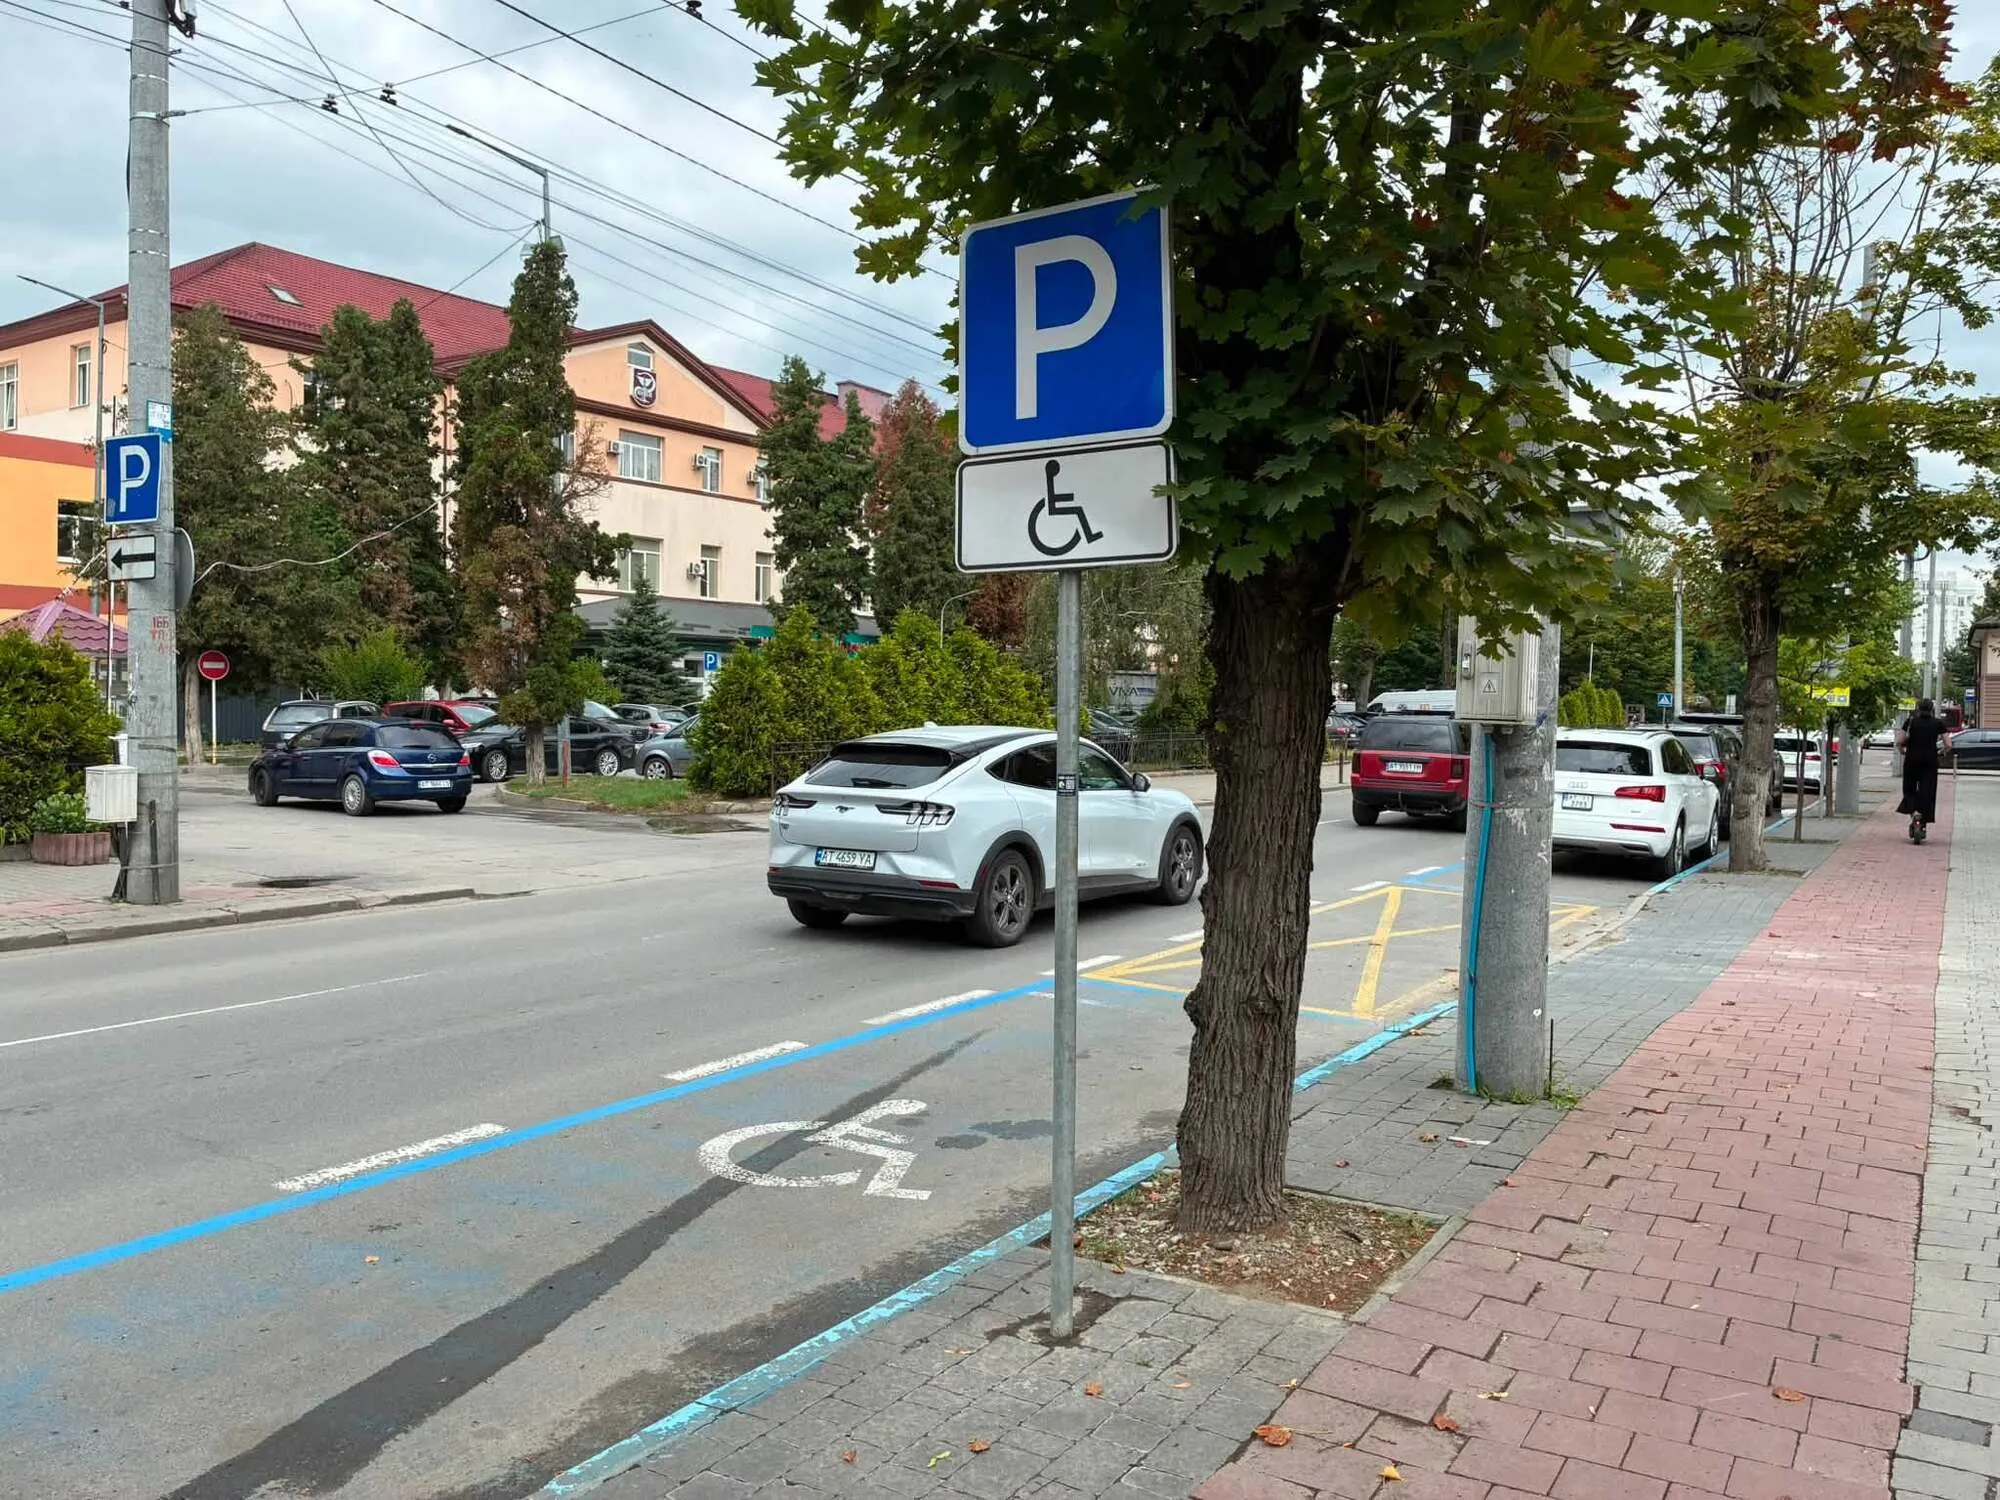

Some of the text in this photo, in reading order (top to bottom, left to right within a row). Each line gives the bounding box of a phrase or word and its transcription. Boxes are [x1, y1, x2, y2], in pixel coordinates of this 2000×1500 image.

[1015, 235, 1117, 420] P
[119, 445, 150, 512] P
[706, 654, 715, 671] P
[822, 851, 872, 866] AT 4659 YA
